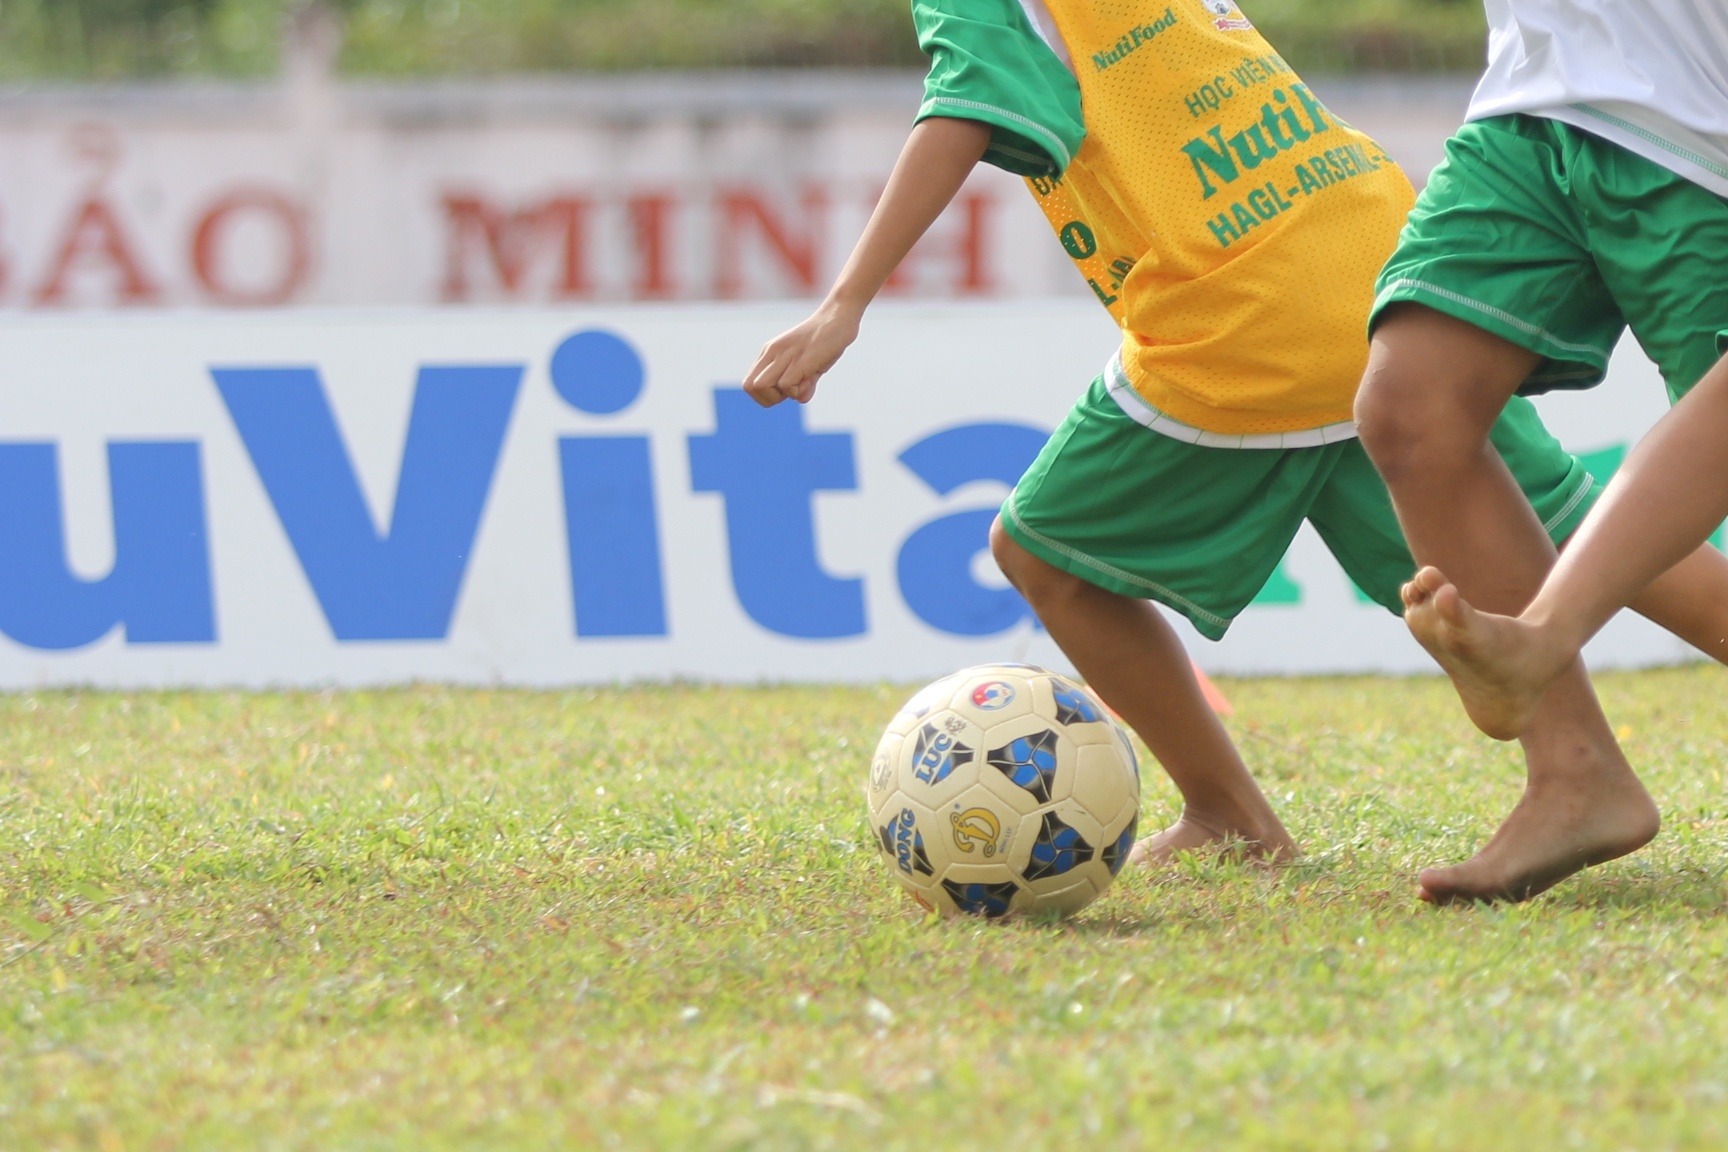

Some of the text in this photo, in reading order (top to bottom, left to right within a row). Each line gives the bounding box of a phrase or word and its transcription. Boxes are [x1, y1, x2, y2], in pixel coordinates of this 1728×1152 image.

[1091, 5, 1179, 73] NutiFood
[1184, 75, 1234, 119] HỌC
[0, 120, 1010, 309] ẢO MINH
